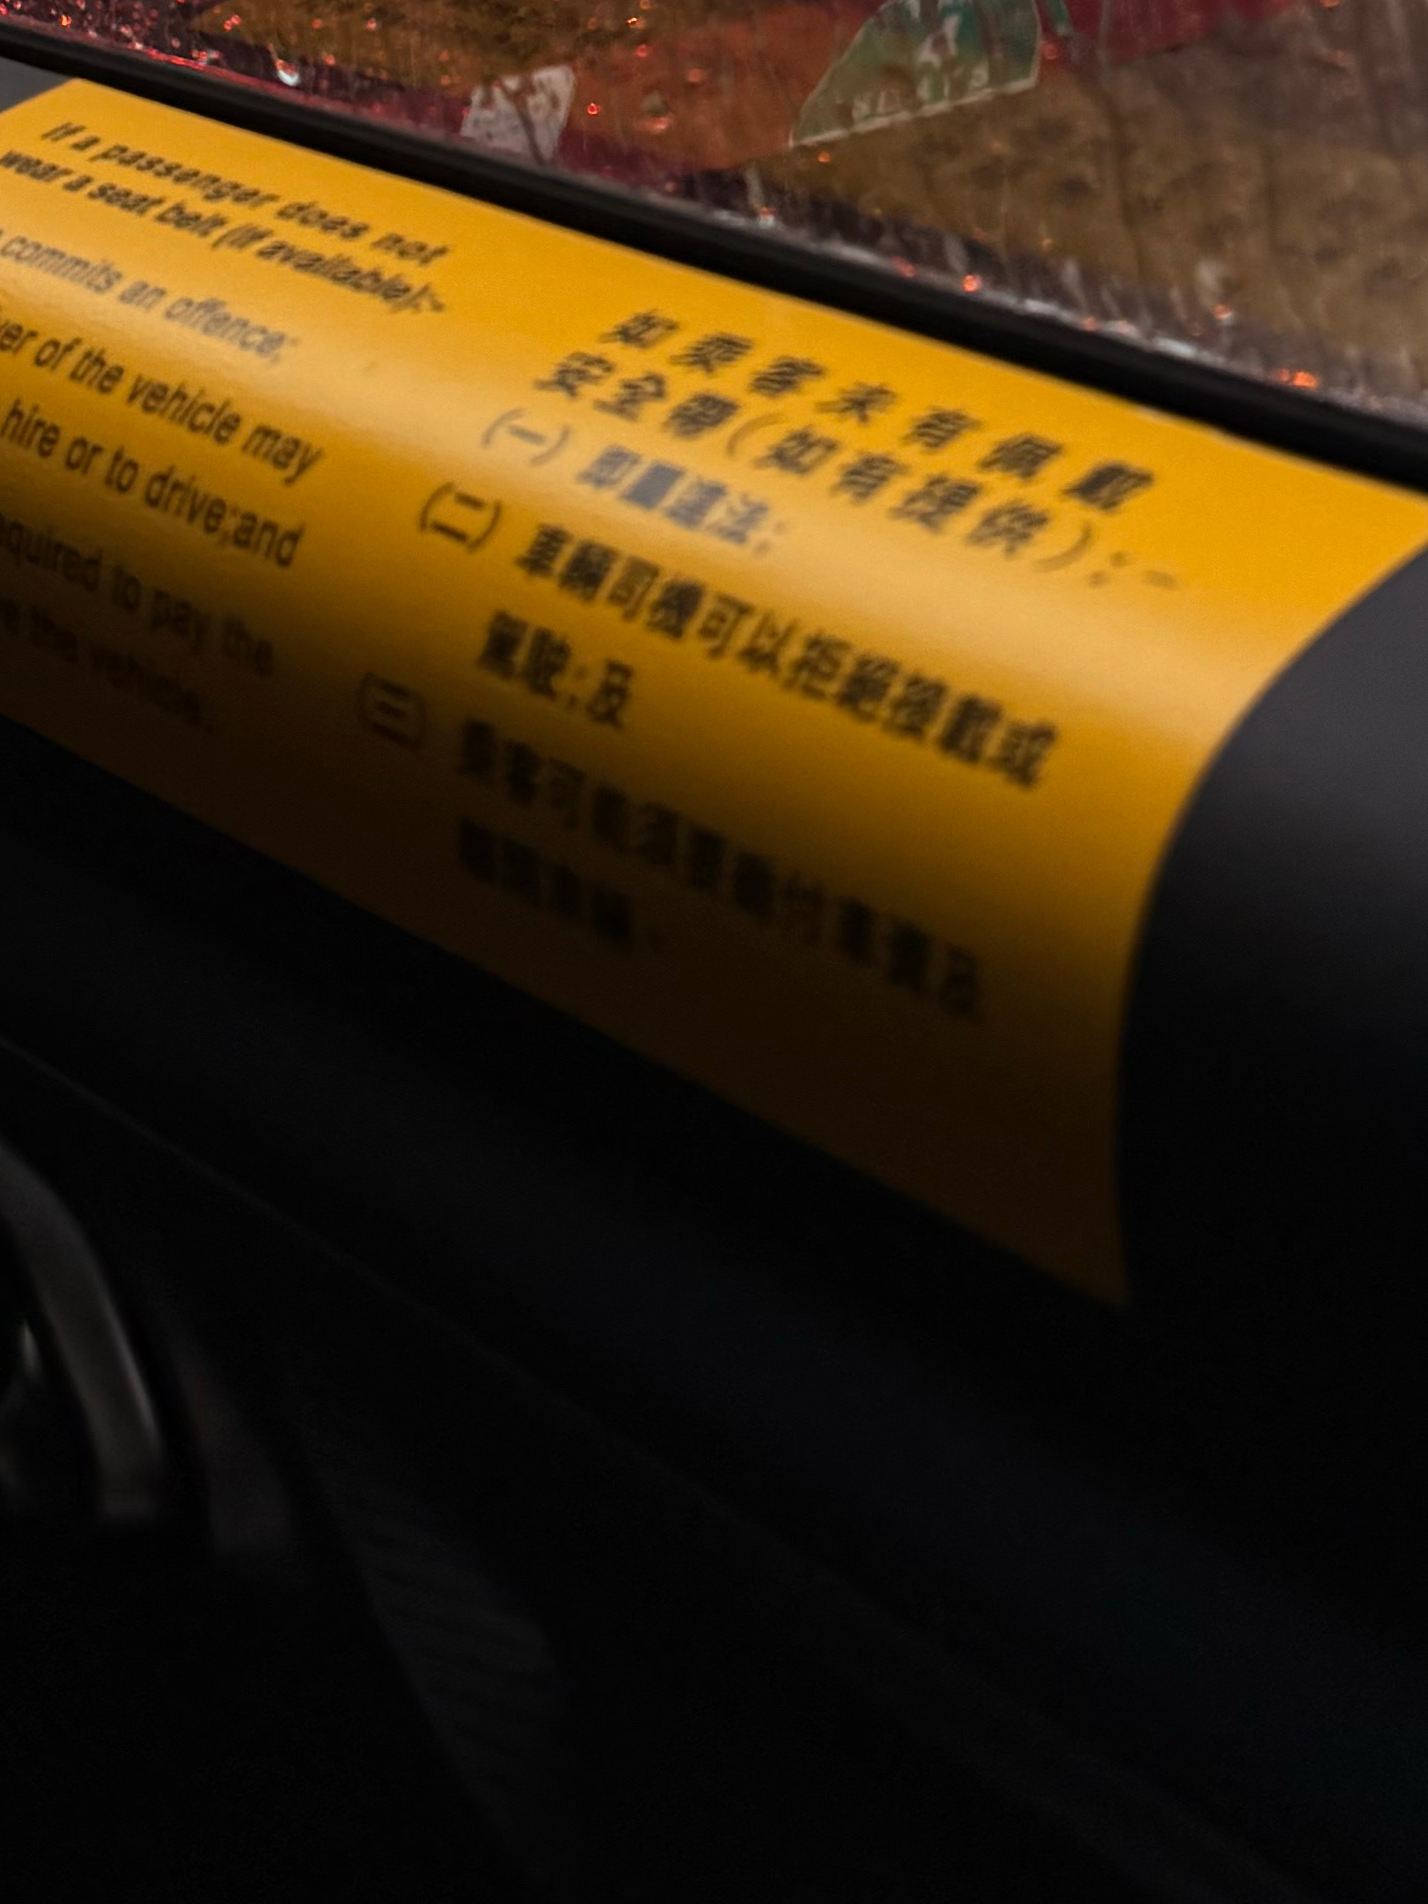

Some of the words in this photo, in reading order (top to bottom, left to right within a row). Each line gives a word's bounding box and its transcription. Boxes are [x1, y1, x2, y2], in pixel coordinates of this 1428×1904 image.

[42, 120, 87, 144] If
[70, 134, 101, 152] a
[89, 138, 280, 206] passenger
[274, 200, 371, 242] does
[372, 231, 448, 267] not
[62, 174, 93, 193] a
[88, 180, 167, 217] seat
[154, 202, 231, 239] belt
[0, 228, 124, 295] commits
[118, 278, 168, 310] an
[0, 397, 62, 460] hire
[63, 435, 105, 476] or
[103, 445, 141, 494] to
[33, 336, 82, 372] of
[69, 346, 125, 394] the
[125, 372, 243, 447] vehicle
[240, 421, 326, 487] may
[484, 407, 572, 467] (一)
[419, 482, 502, 554] (二)
[110, 562, 142, 614] to
[147, 588, 211, 655] pay
[220, 618, 275, 679] the
